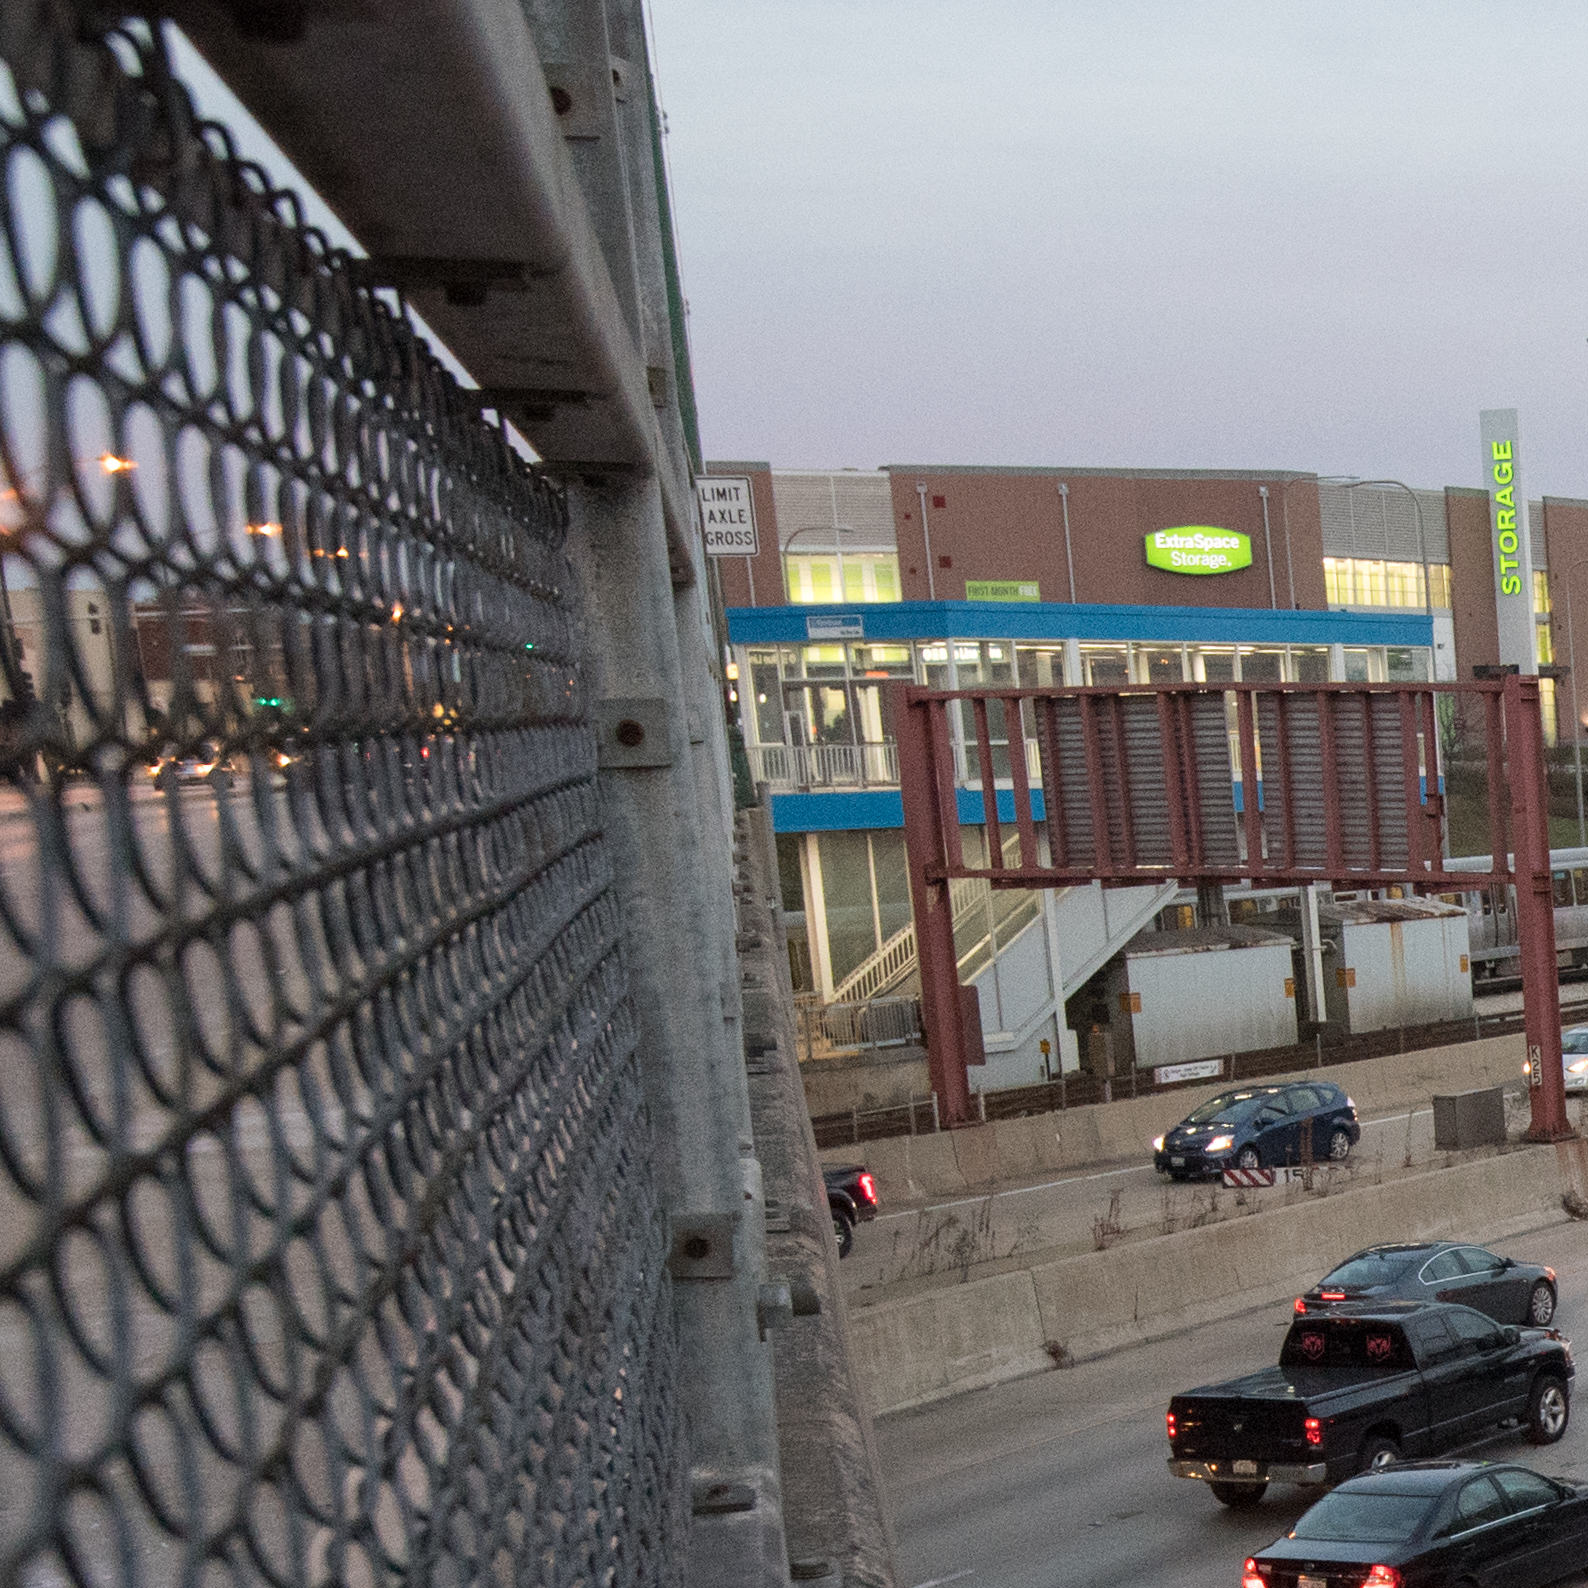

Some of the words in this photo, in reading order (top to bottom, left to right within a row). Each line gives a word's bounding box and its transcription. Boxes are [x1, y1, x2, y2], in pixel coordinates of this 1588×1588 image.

[702, 487, 740, 502] LIMIT
[708, 509, 747, 524] AXLE
[1492, 440, 1521, 595] STORAGE
[706, 531, 753, 546] GROSS
[968, 586, 988, 597] FIRST
[1531, 1046, 1541, 1085] K25
